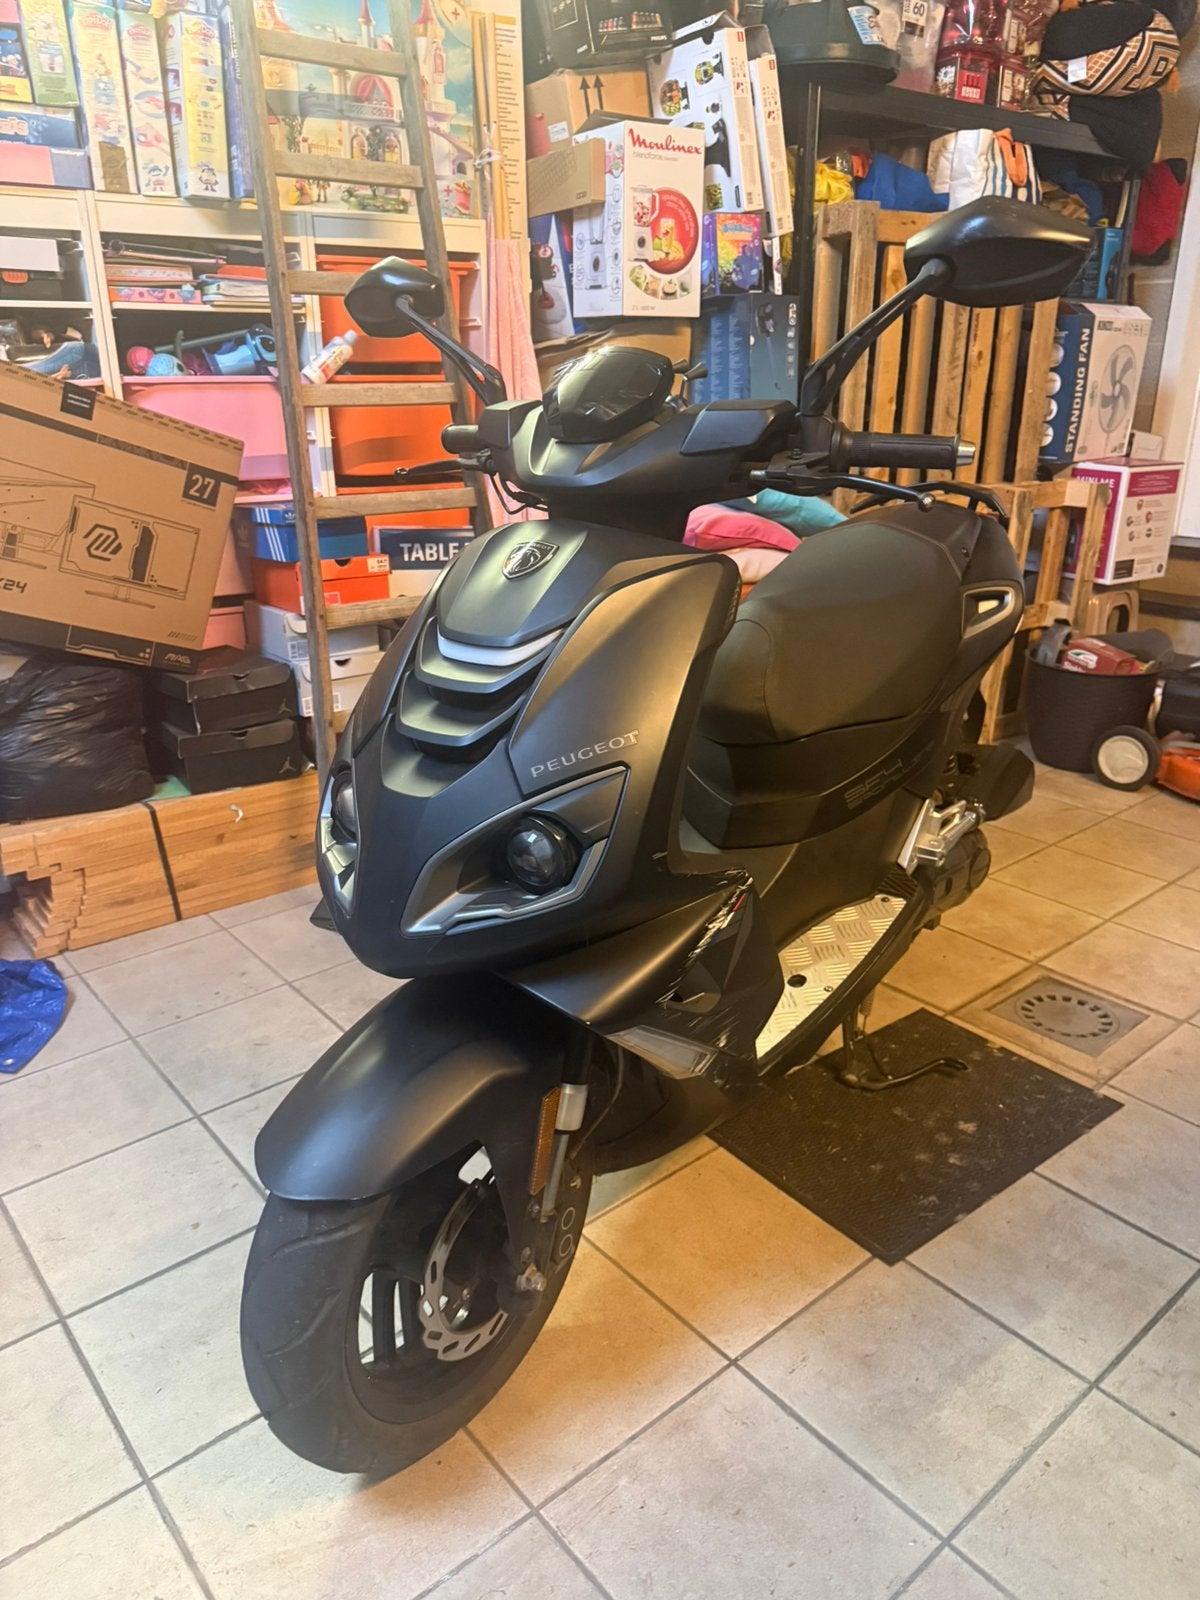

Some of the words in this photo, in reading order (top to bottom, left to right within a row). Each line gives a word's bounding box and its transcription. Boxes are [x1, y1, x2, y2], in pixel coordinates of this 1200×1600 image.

[912, 1, 926, 17] 60
[628, 127, 703, 155] Moulinex
[1064, 371, 1087, 453] STANDING
[1079, 328, 1091, 363] FAN
[188, 473, 216, 500] 27
[530, 729, 640, 779] PEUGEOT
